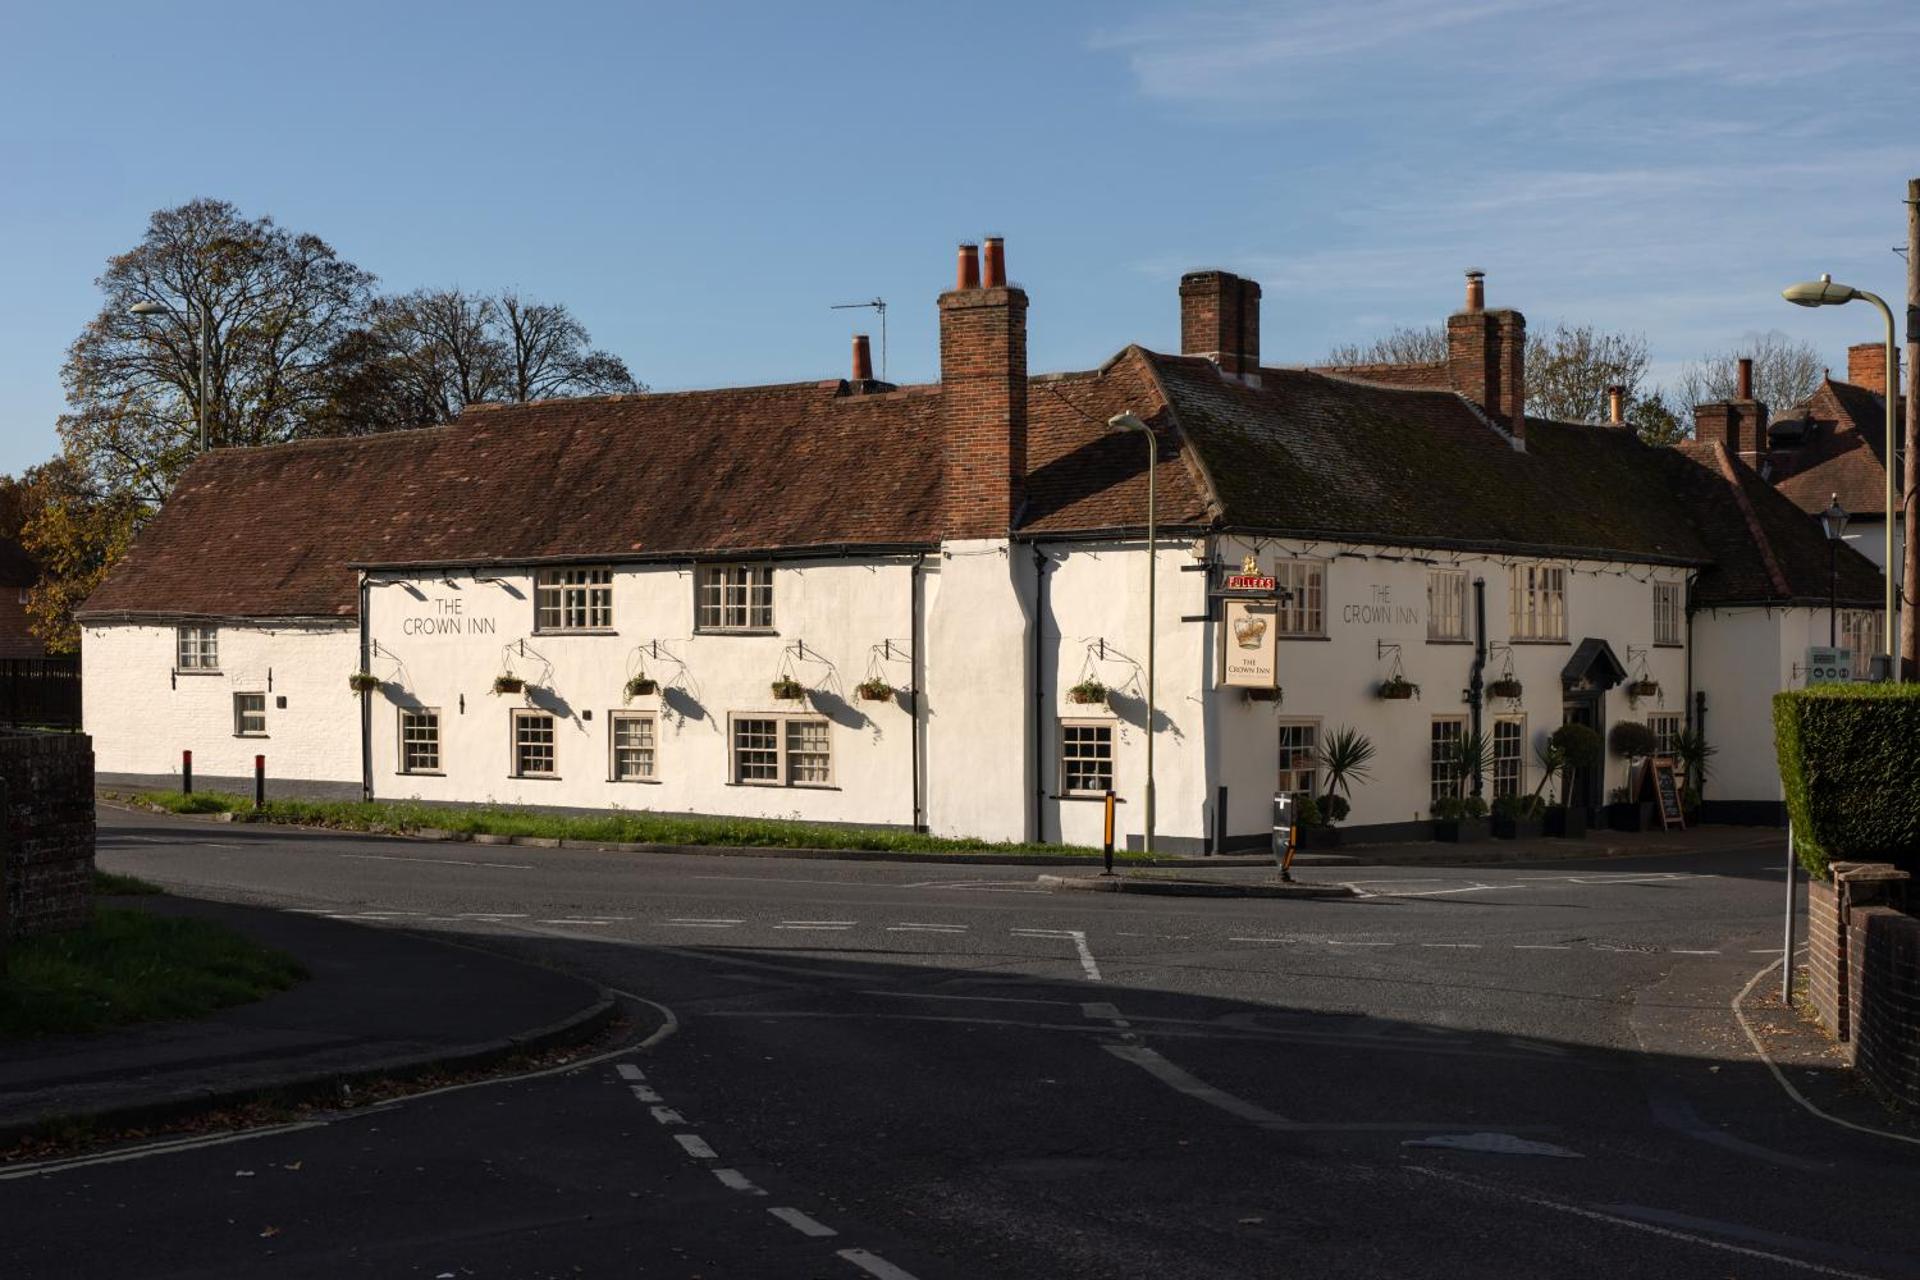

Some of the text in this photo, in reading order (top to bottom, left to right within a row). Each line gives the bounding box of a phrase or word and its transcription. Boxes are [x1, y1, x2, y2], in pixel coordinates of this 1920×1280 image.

[1369, 584, 1391, 604] THE
[435, 598, 463, 615] THE
[1343, 604, 1418, 625] CROWN INN
[402, 617, 496, 636] CROWN INN
[1242, 658, 1256, 666] THE
